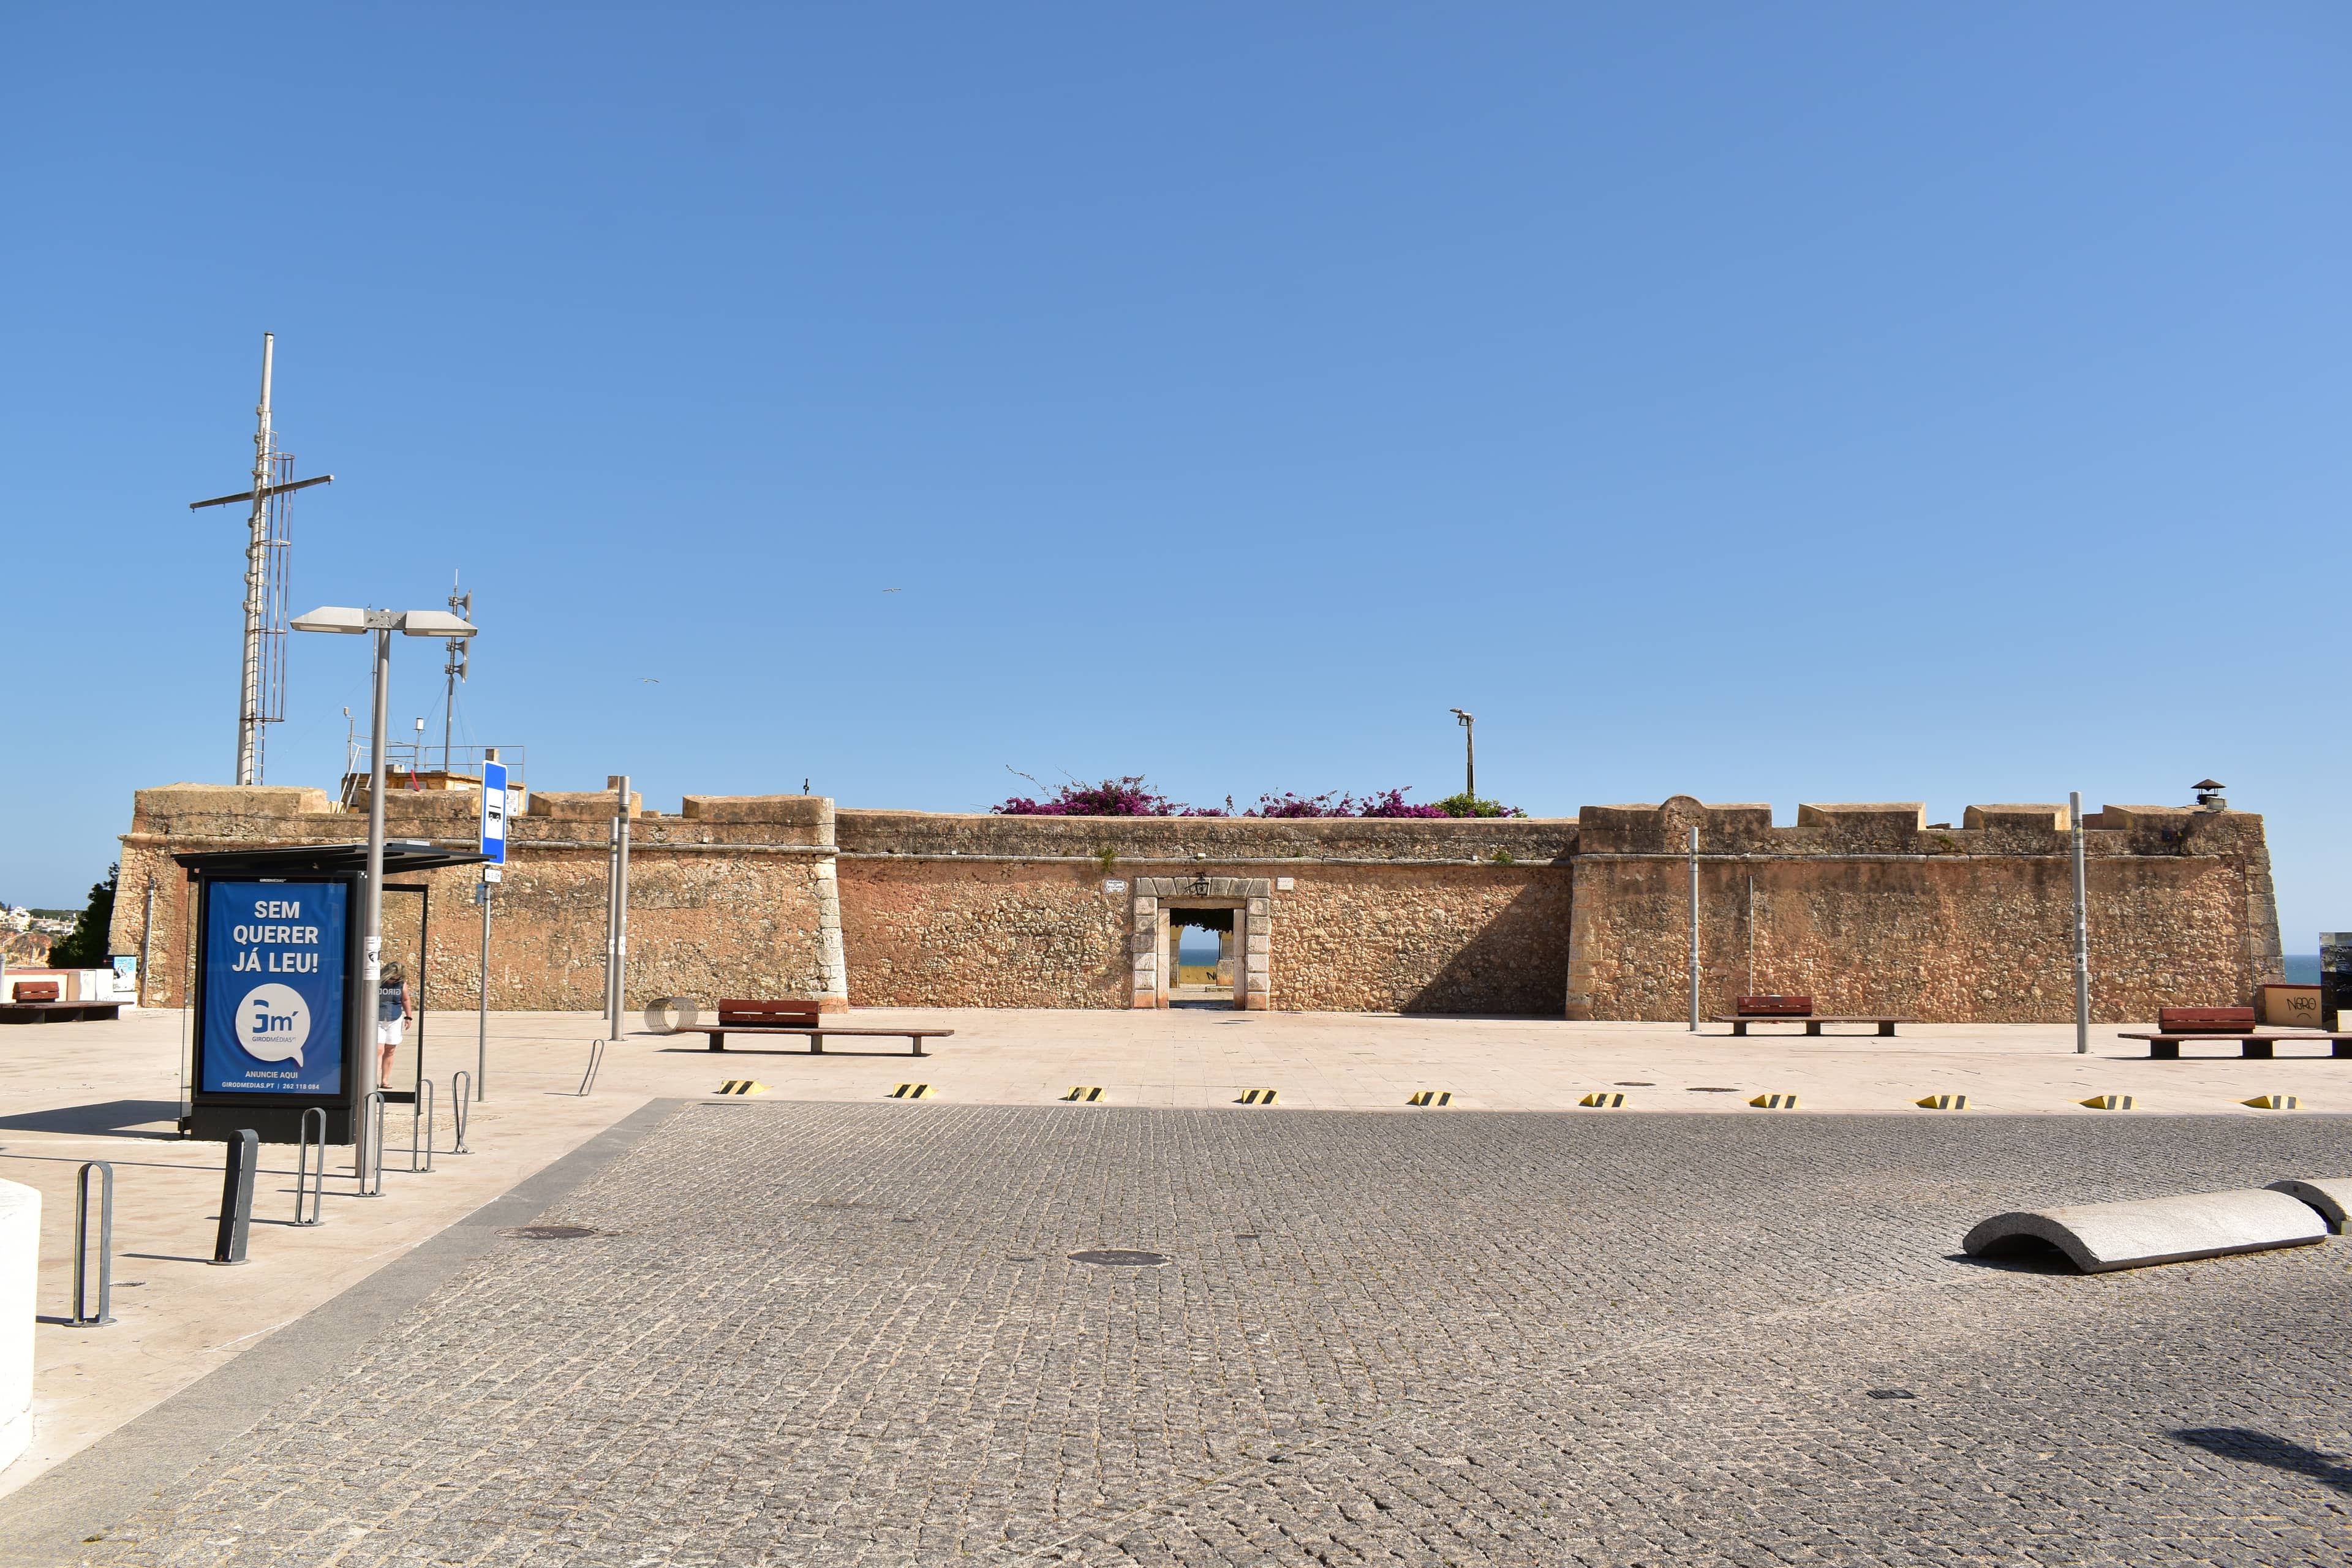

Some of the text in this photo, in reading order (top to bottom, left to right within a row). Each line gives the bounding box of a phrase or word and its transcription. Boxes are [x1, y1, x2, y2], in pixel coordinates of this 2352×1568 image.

[254, 901, 300, 919] SEM
[233, 925, 318, 944] QUERER
[232, 948, 318, 973] JÁ LEU!
